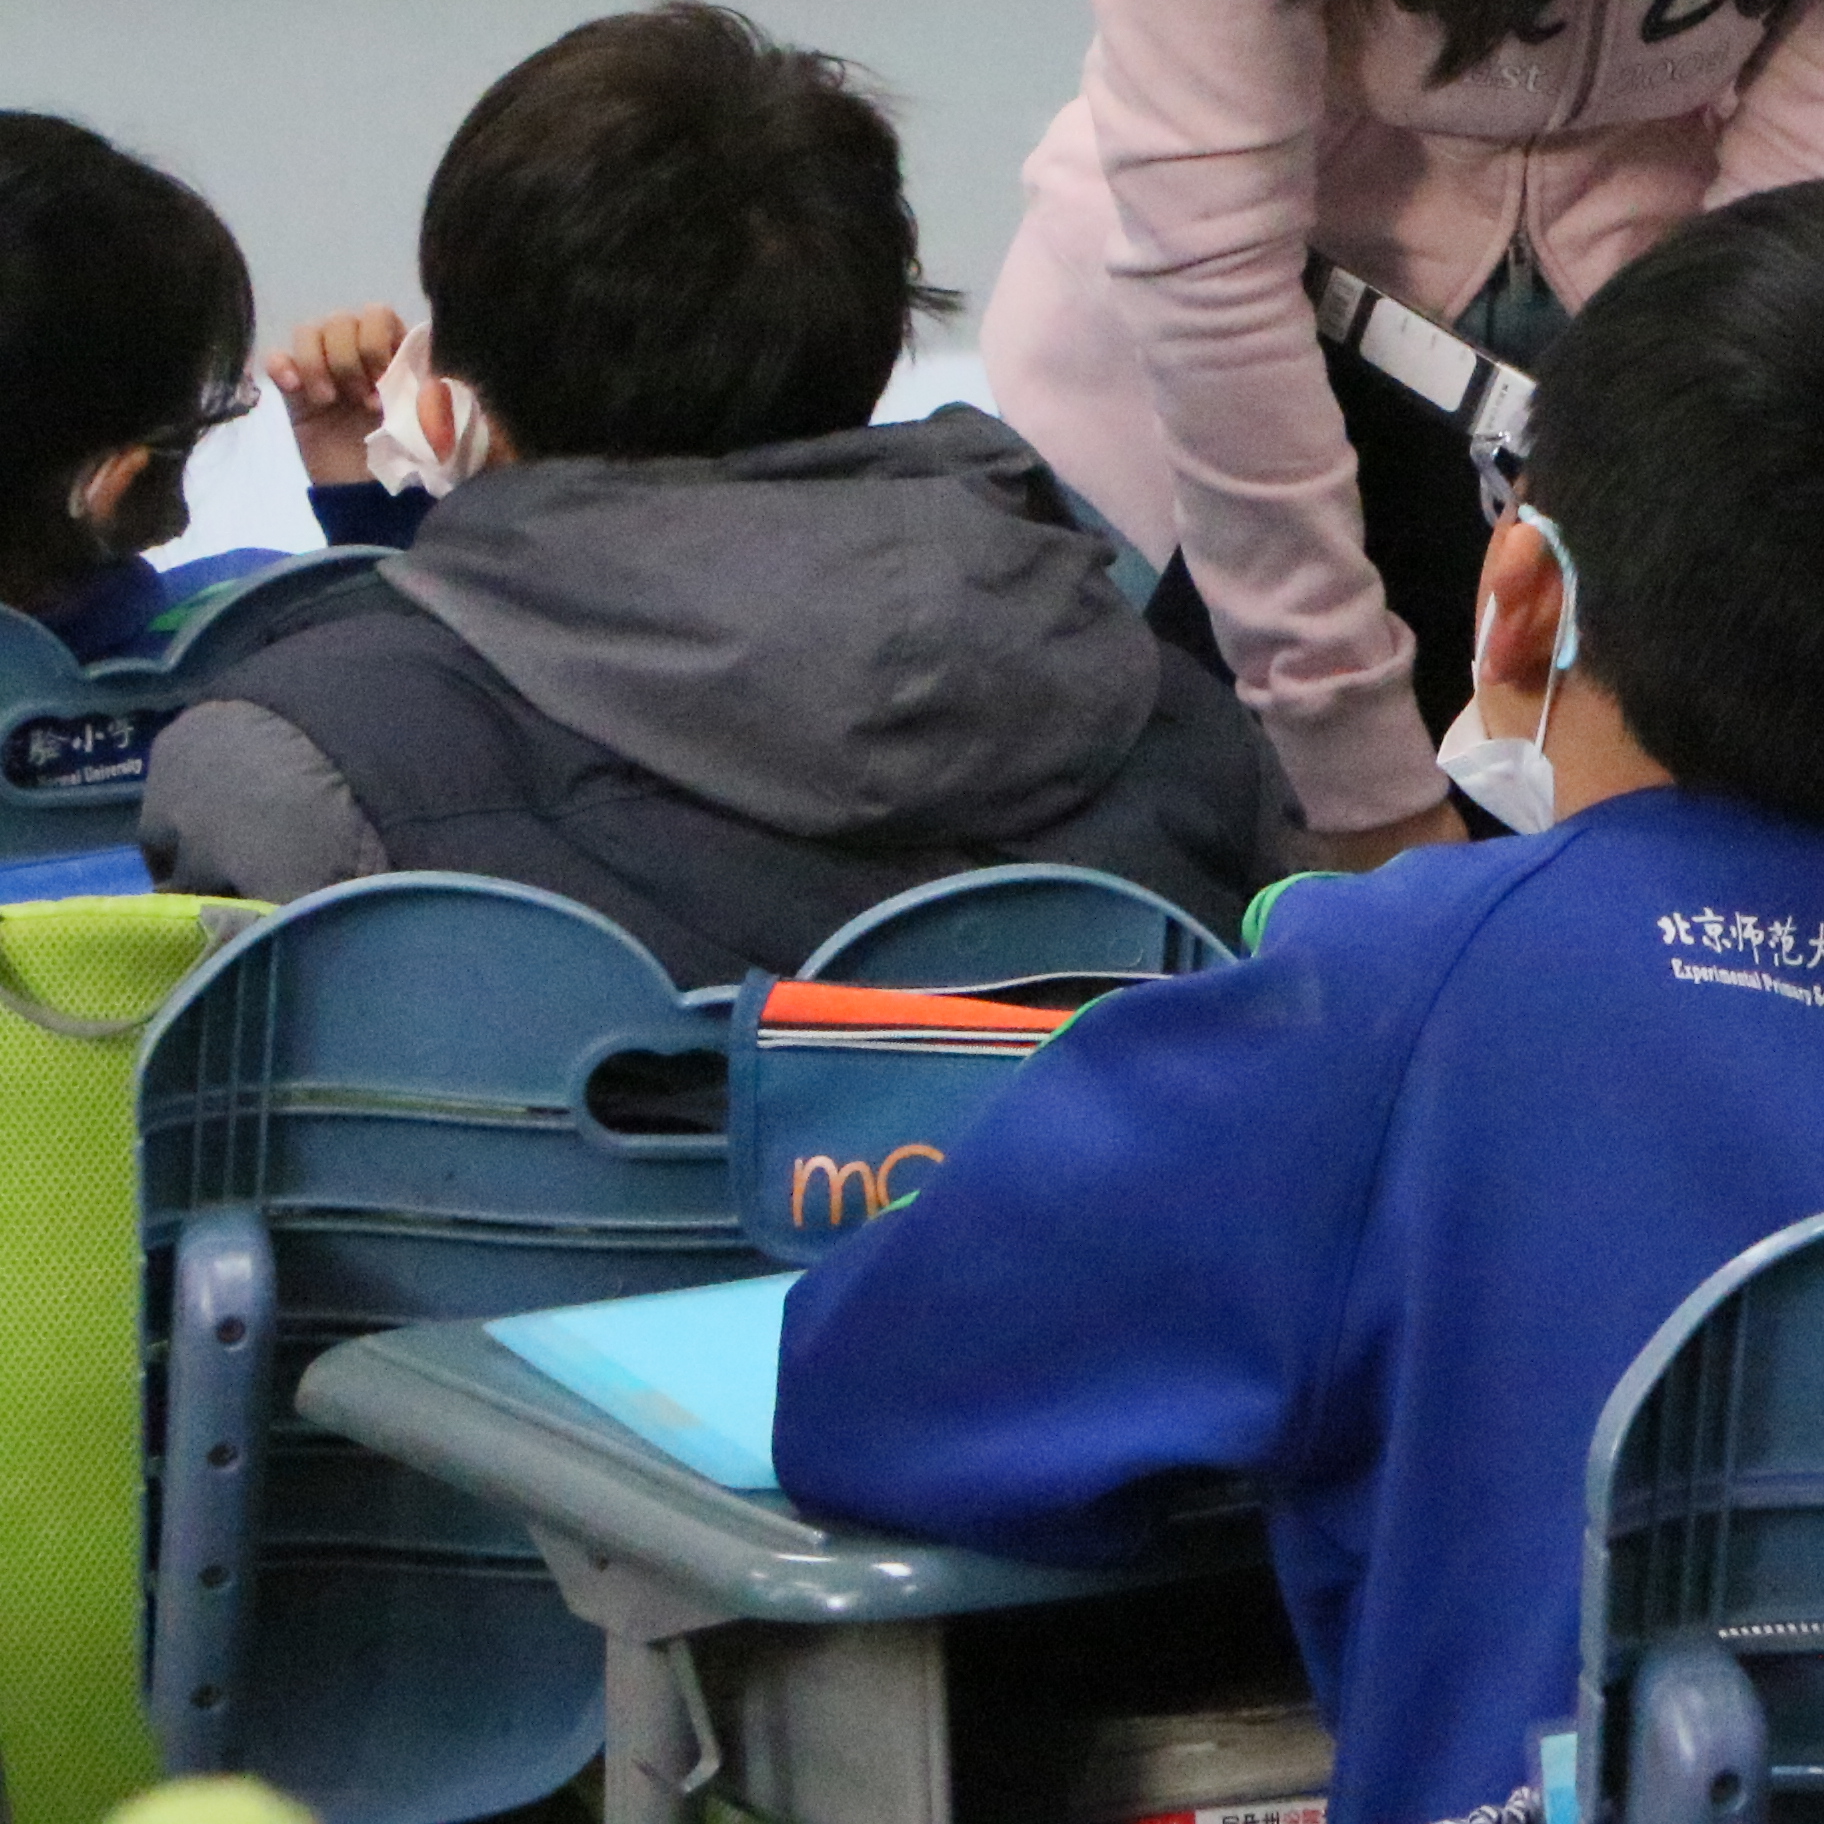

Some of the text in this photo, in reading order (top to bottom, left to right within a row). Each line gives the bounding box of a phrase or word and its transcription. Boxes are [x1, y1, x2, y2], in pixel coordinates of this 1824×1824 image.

[84, 757, 143, 783] University
[1670, 957, 1763, 991] Experimental
[1761, 973, 1812, 1006] Primary
